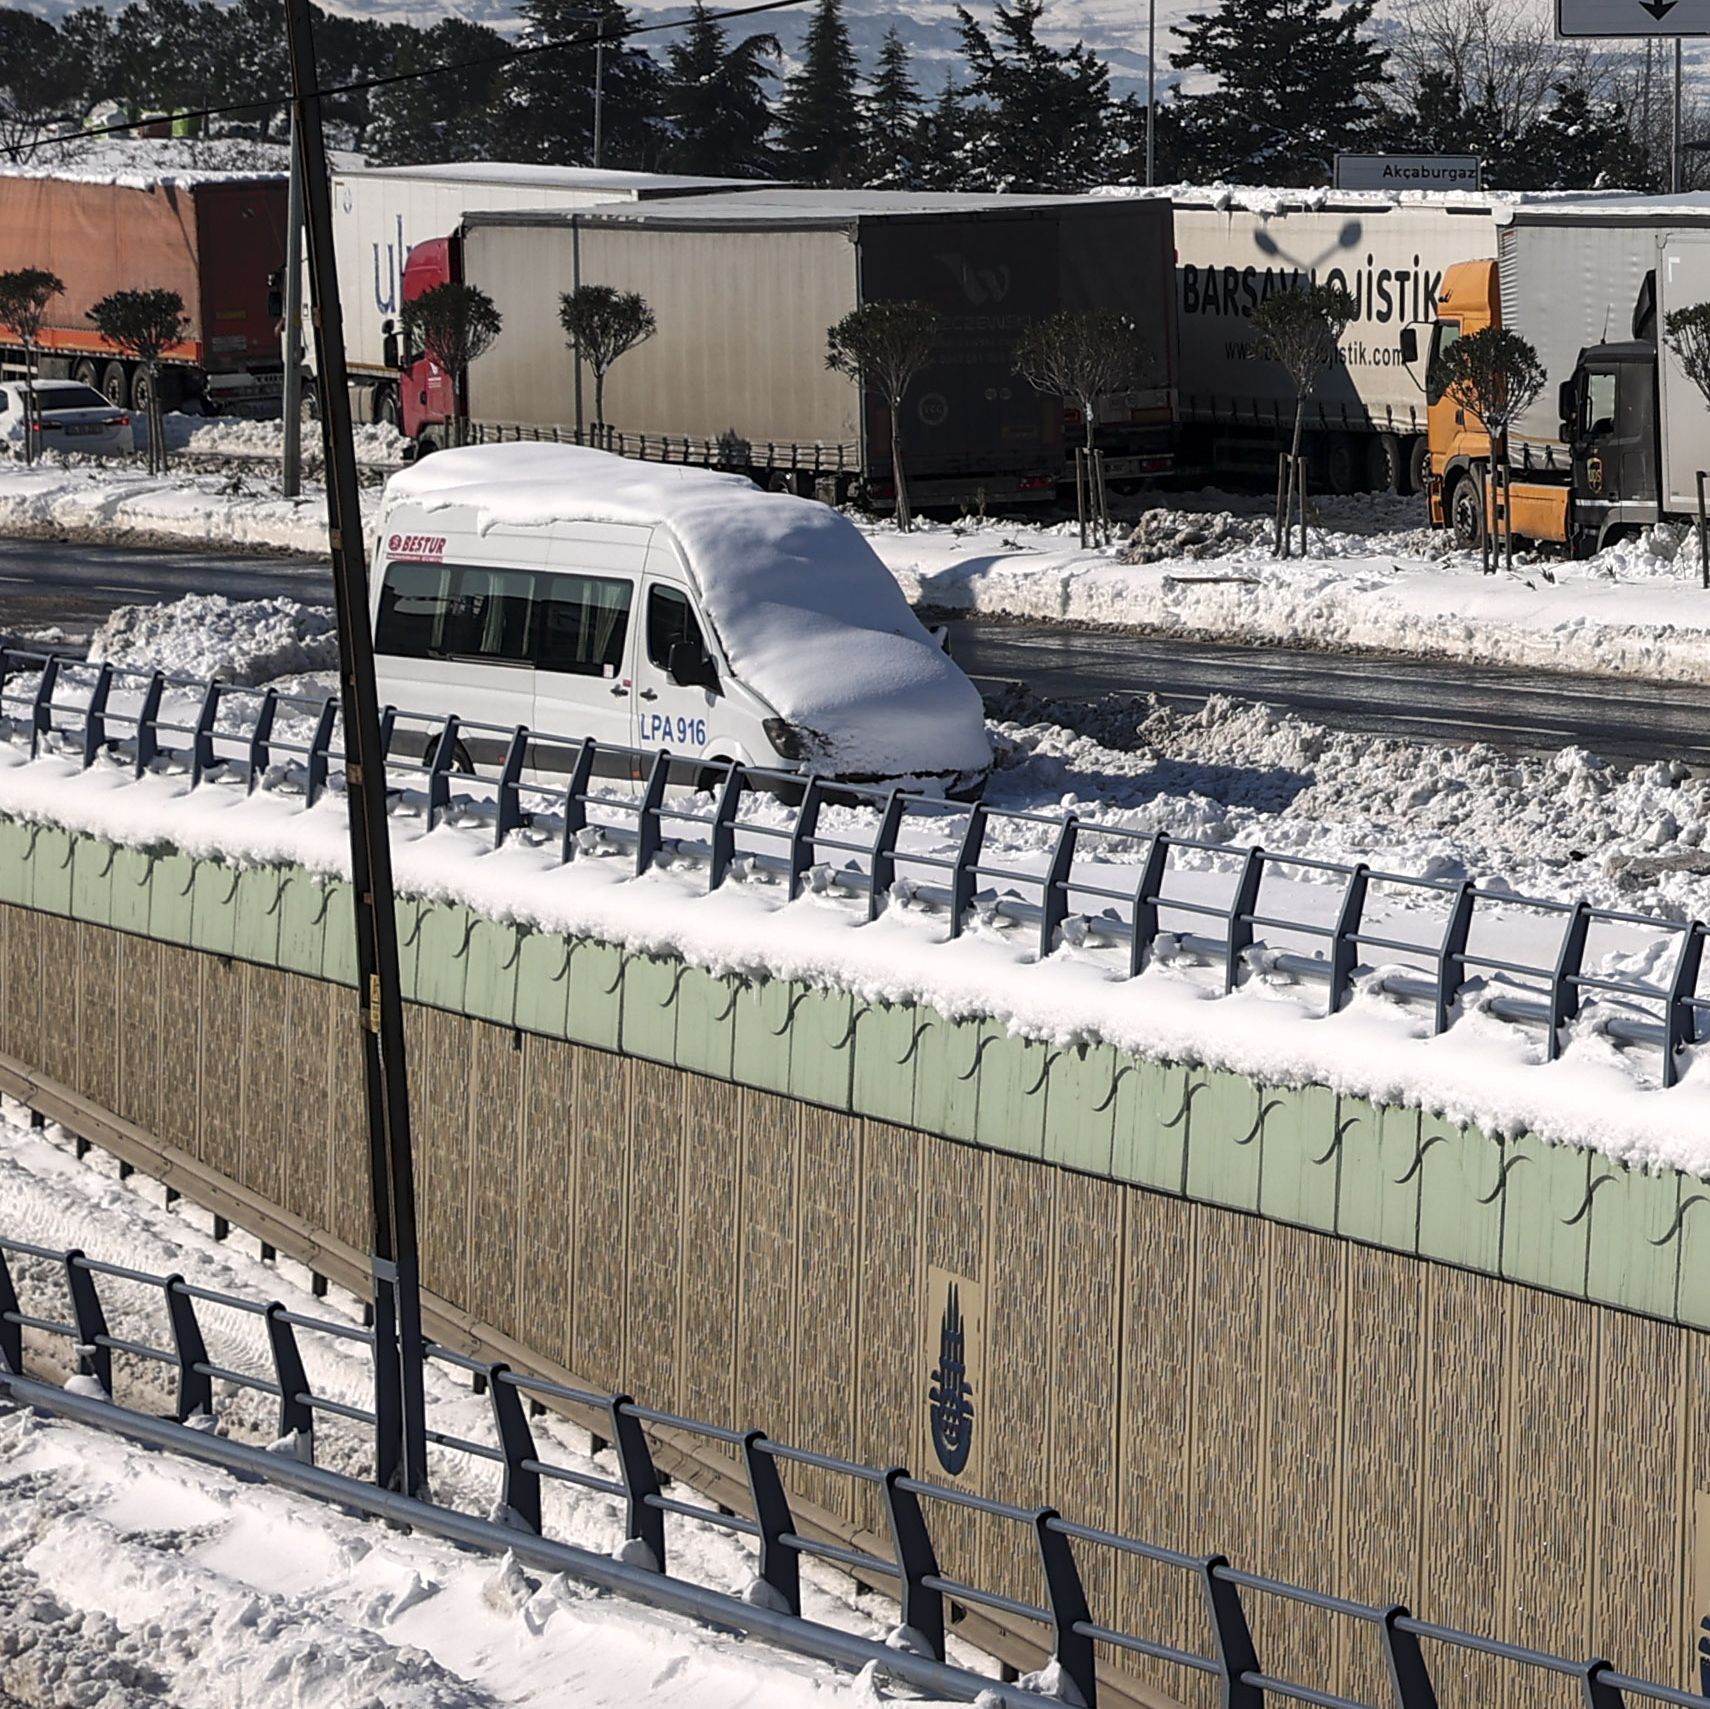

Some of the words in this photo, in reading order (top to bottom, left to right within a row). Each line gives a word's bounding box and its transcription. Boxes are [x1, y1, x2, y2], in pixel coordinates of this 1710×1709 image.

[1383, 165, 1477, 182] Akçaburgaz
[402, 535, 447, 554] BESTUR
[641, 713, 675, 743] LPA
[677, 717, 706, 746] 916
